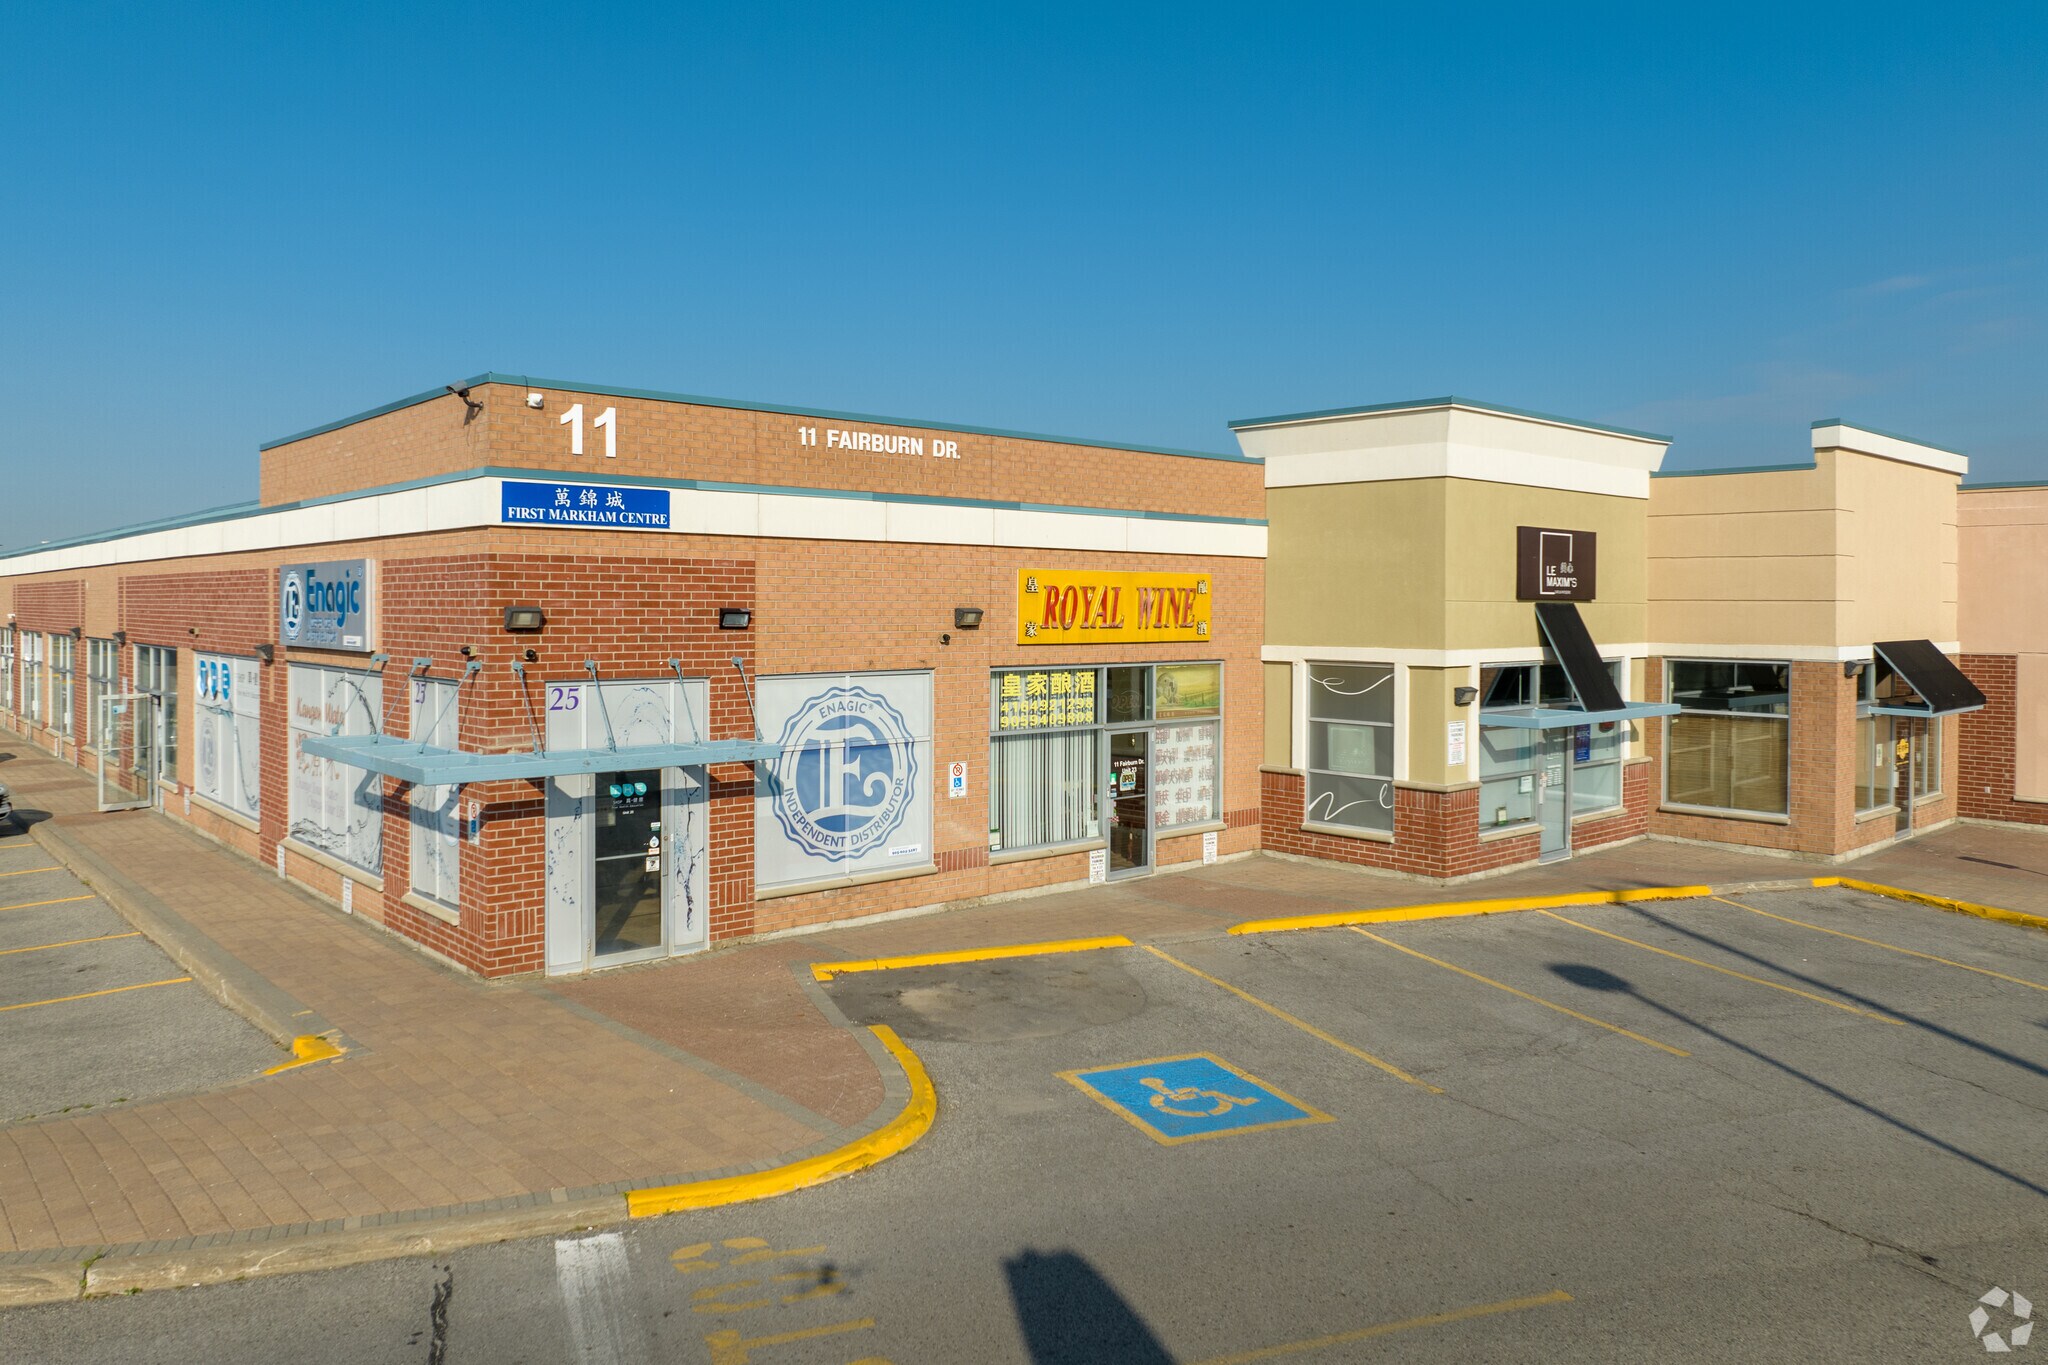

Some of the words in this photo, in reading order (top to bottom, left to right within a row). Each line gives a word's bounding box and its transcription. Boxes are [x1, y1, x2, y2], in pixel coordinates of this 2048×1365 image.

[560, 403, 617, 458] 11
[798, 426, 816, 447] 11
[827, 429, 923, 456] FAIRBURN
[932, 439, 961, 459] DR.
[554, 487, 625, 510] 萬錦城
[507, 506, 546, 519] FIRST
[549, 508, 617, 523] MARKHAM
[619, 511, 668, 525] CENTRE
[1546, 565, 1557, 576] LE
[1546, 576, 1578, 588] MAXIM'S
[306, 569, 360, 628] Enagic
[1040, 585, 1124, 630] ROYAL
[1136, 586, 1197, 630] WINE
[550, 687, 579, 711] 25
[784, 787, 846, 848] INDEPENDENT
[850, 777, 905, 846] DISTRIBUTOR
